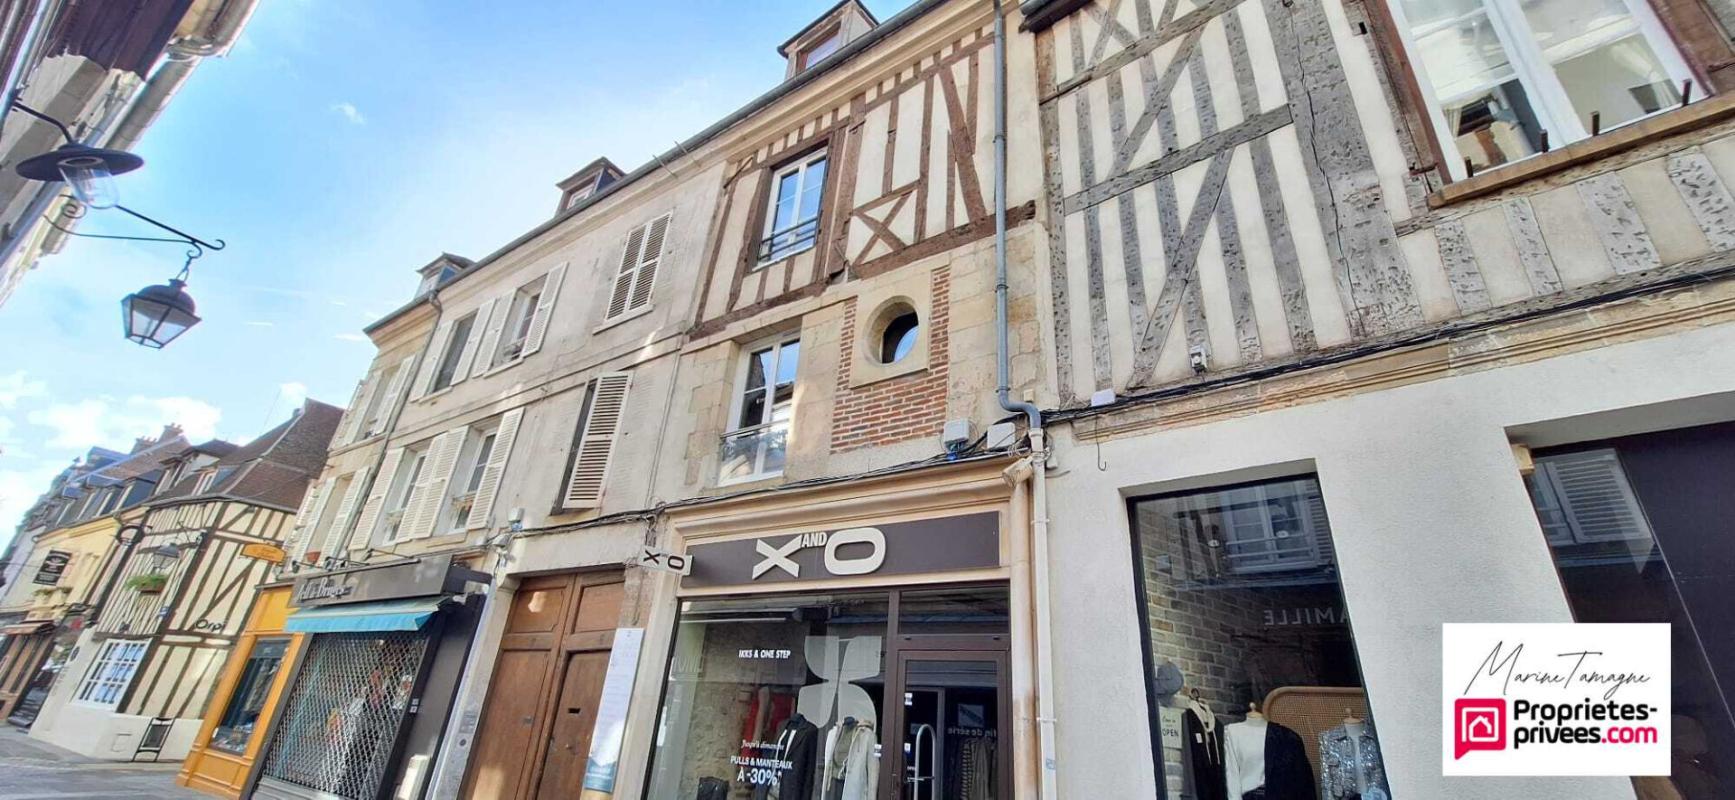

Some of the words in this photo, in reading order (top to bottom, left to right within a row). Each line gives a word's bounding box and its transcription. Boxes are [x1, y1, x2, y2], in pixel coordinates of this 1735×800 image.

[801, 532, 828, 548] AND
[196, 619, 227, 632] Orpi
[761, 650, 775, 659] ONE
[776, 650, 791, 659] STEP
[730, 755, 750, 766] PULLS
[750, 758, 756, 766] &
[756, 758, 793, 770] MANTEAUX
